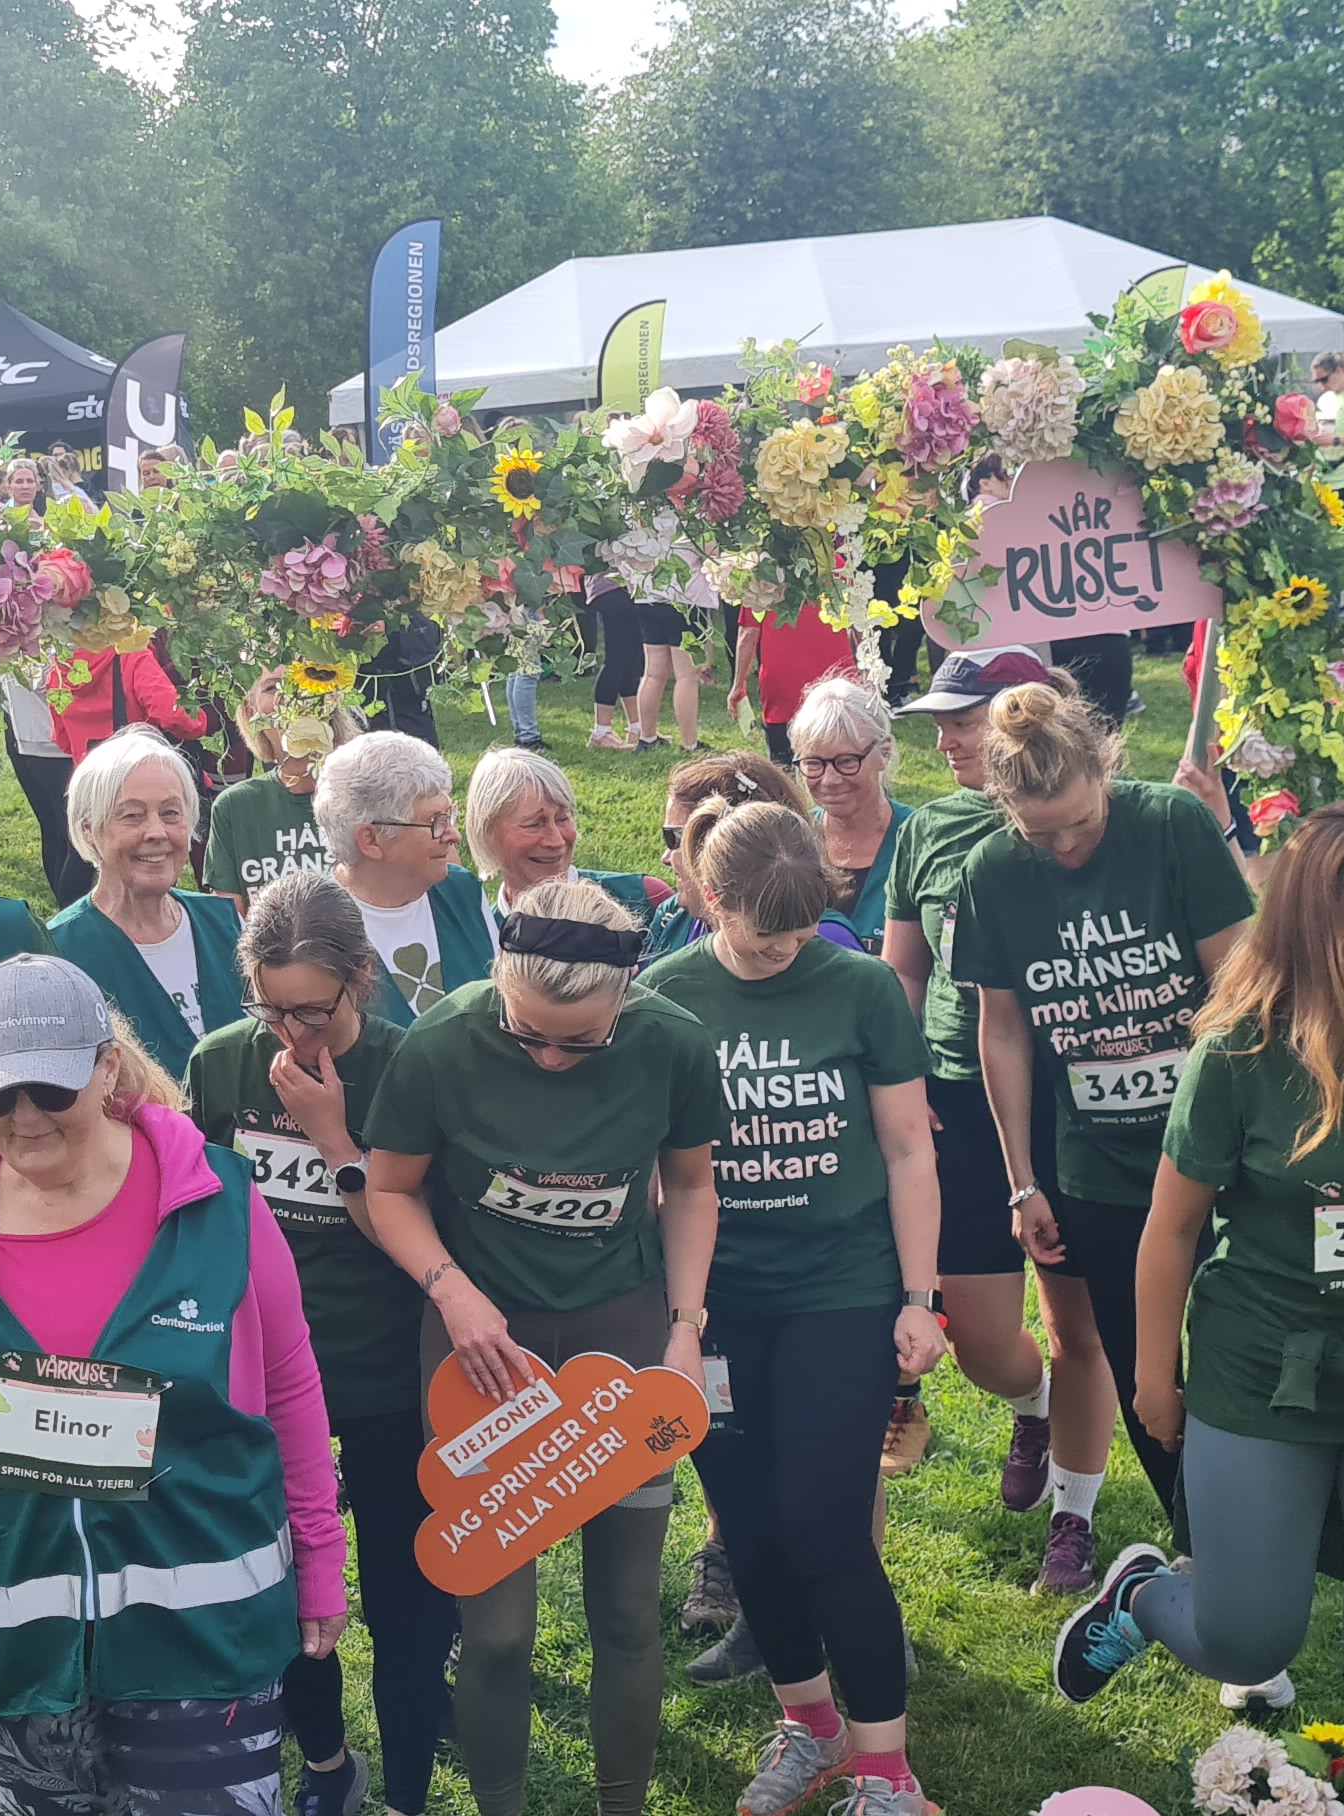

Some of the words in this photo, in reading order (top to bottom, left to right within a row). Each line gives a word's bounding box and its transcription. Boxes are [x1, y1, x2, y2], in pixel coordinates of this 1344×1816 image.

[406, 241, 424, 376] DSREGIONEN
[1048, 491, 1112, 536] VÅR
[1006, 531, 1163, 618] RUSET
[276, 822, 328, 852] HÅL
[241, 850, 336, 882] GRÄN
[1058, 910, 1146, 950] HÅLL
[1025, 932, 1182, 992] GRÄNSEN
[1031, 994, 1092, 1027] mot
[1095, 972, 1195, 1016] klimat-
[1050, 1007, 1194, 1055] förnekare
[1091, 1035, 1154, 1056] VÅRRUSET
[721, 1069, 845, 1111] NSEN
[1085, 1063, 1180, 1102] 3423
[730, 1111, 848, 1146] klimat-
[255, 1148, 341, 1196] 342
[538, 1172, 608, 1188] VÅRRUSET
[710, 1151, 838, 1182] rnekare
[292, 1212, 314, 1222] ALLA
[496, 1187, 612, 1220] 3420
[722, 1193, 809, 1211] Centerpartiet
[151, 1314, 225, 1333] Centerpartiet
[36, 1354, 123, 1386] VÅRRUSET
[34, 1408, 112, 1438] Elinor
[448, 1389, 551, 1466] TJEJZONEN
[644, 1415, 690, 1455] RUSET
[0, 1465, 39, 1480] SPRING
[42, 1470, 63, 1485] FÖR
[66, 1476, 94, 1488] ALLA
[97, 1478, 134, 1490] TJEJER!
[440, 1508, 483, 1554] JAG
[479, 1418, 587, 1515] SPRINGER
[580, 1377, 634, 1425] FÖR
[493, 1495, 554, 1550] ALLA
[546, 1426, 628, 1498] TJEJER!
